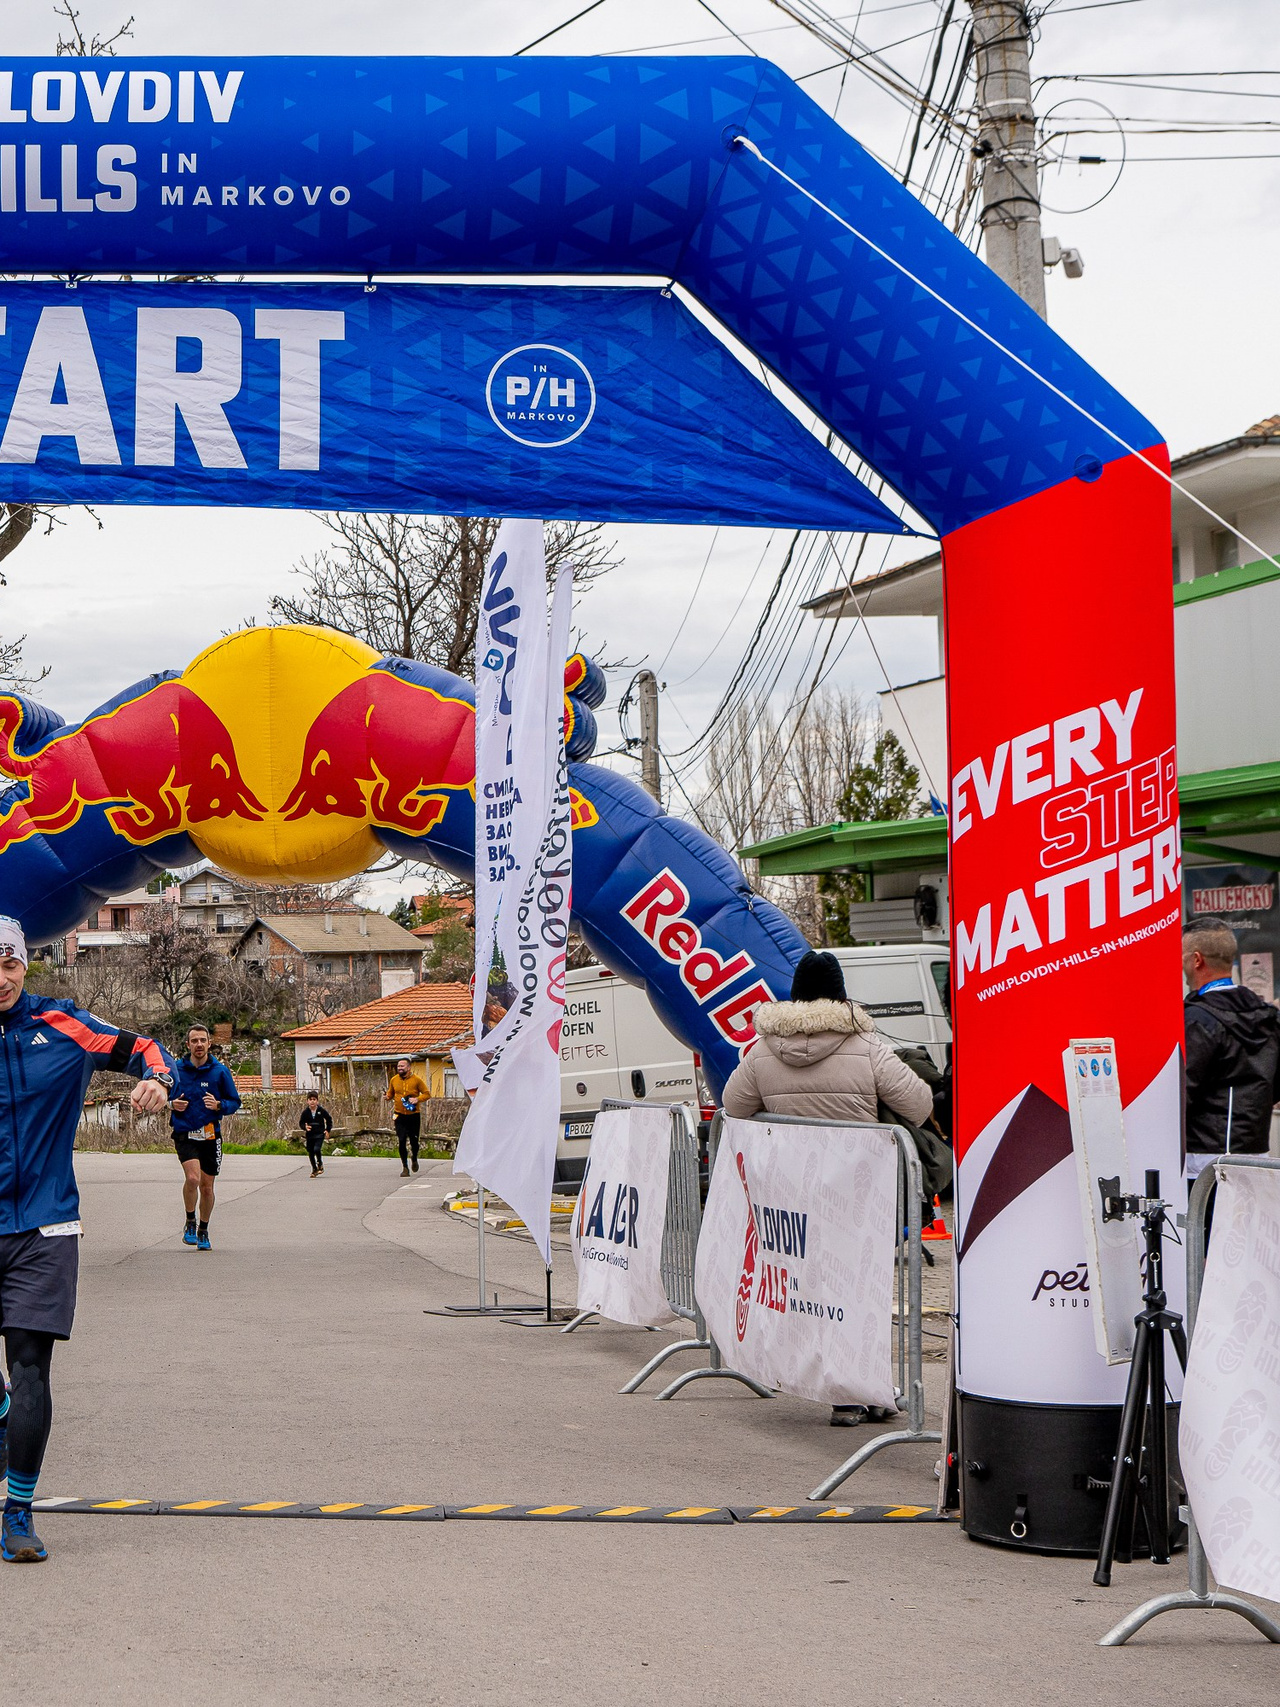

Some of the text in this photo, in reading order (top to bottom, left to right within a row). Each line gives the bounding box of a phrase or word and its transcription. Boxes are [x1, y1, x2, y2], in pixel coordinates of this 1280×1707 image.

[161, 153, 196, 173] IN
[161, 186, 351, 206] MARKOVO
[506, 376, 576, 409] P/H
[507, 412, 575, 422] MARKOVO
[952, 687, 1144, 844] EVERY
[1040, 745, 1178, 869] STEP
[625, 872, 750, 1000] Red
[977, 907, 1180, 1002] WWW.PLOVDIV-HILLS-IN-MARKOVO.COM
[562, 1021, 594, 1037] ÖFEN
[559, 1044, 609, 1062] EITER
[655, 1078, 693, 1088] DUCATO
[790, 1276, 798, 1291] IN
[790, 1298, 844, 1322] MARKOVO
[1050, 1298, 1089, 1308] STUD
